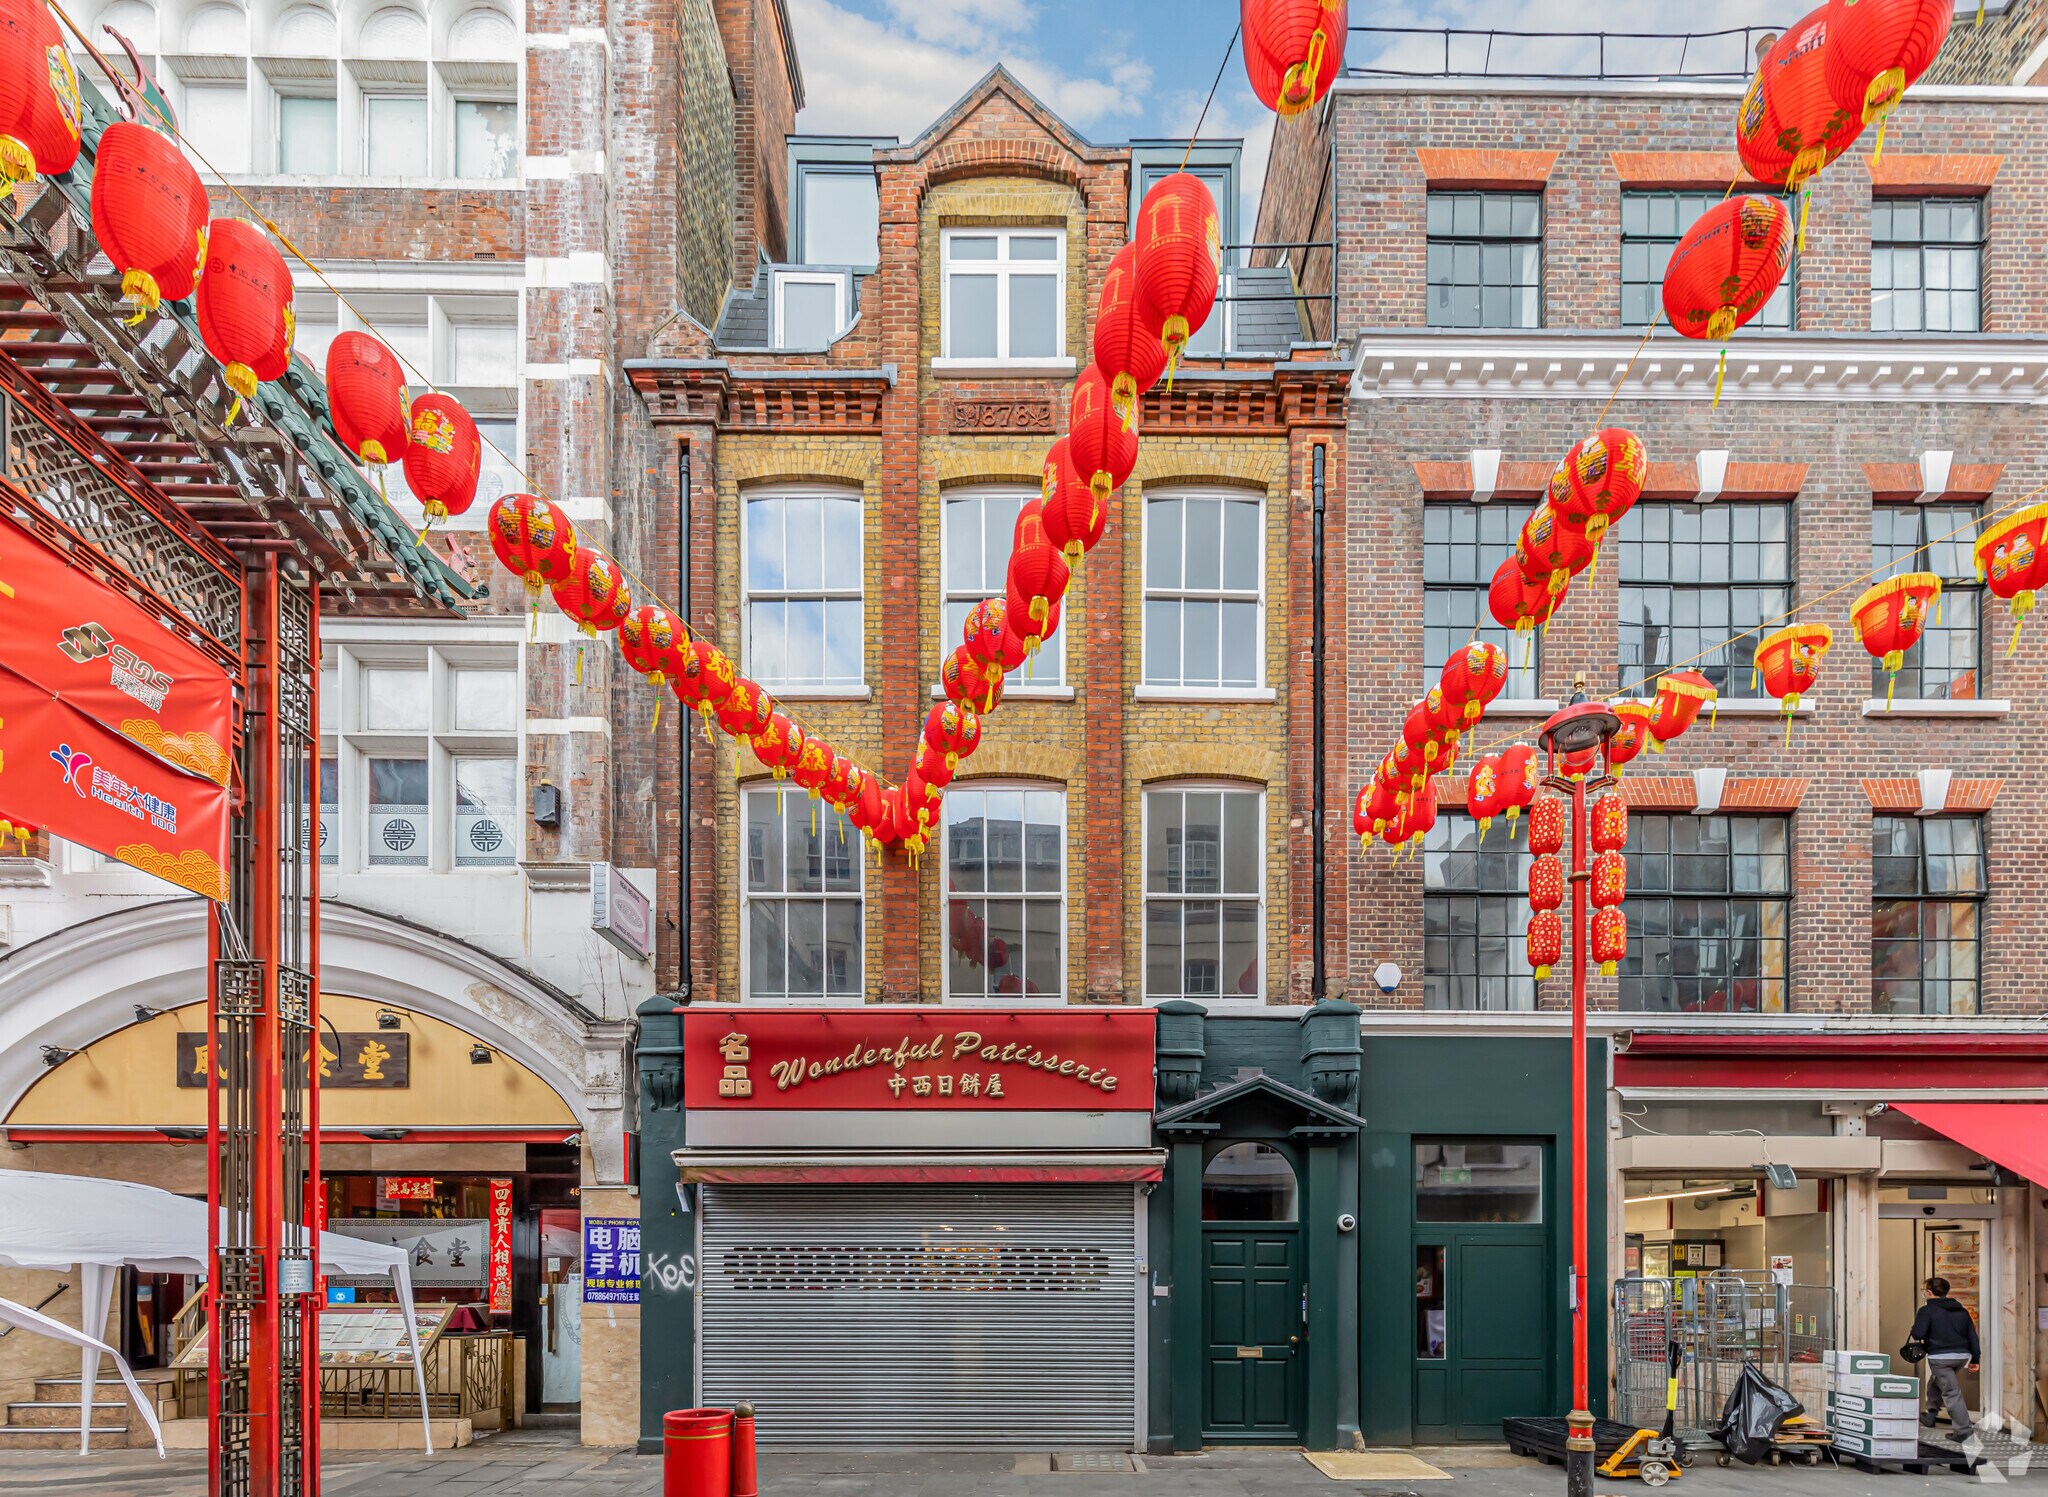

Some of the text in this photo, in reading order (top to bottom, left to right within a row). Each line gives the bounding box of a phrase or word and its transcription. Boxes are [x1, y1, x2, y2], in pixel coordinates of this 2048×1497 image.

[973, 403, 1031, 428] 1878
[92, 766, 176, 824] 美年大健康
[92, 786, 176, 835] Health 100
[719, 1032, 752, 1097] 名品
[770, 1031, 1119, 1093] Wonderful Patisserie
[569, 1187, 581, 1196] 46
[589, 1227, 640, 1251] 电脑
[590, 1252, 640, 1276] 手机
